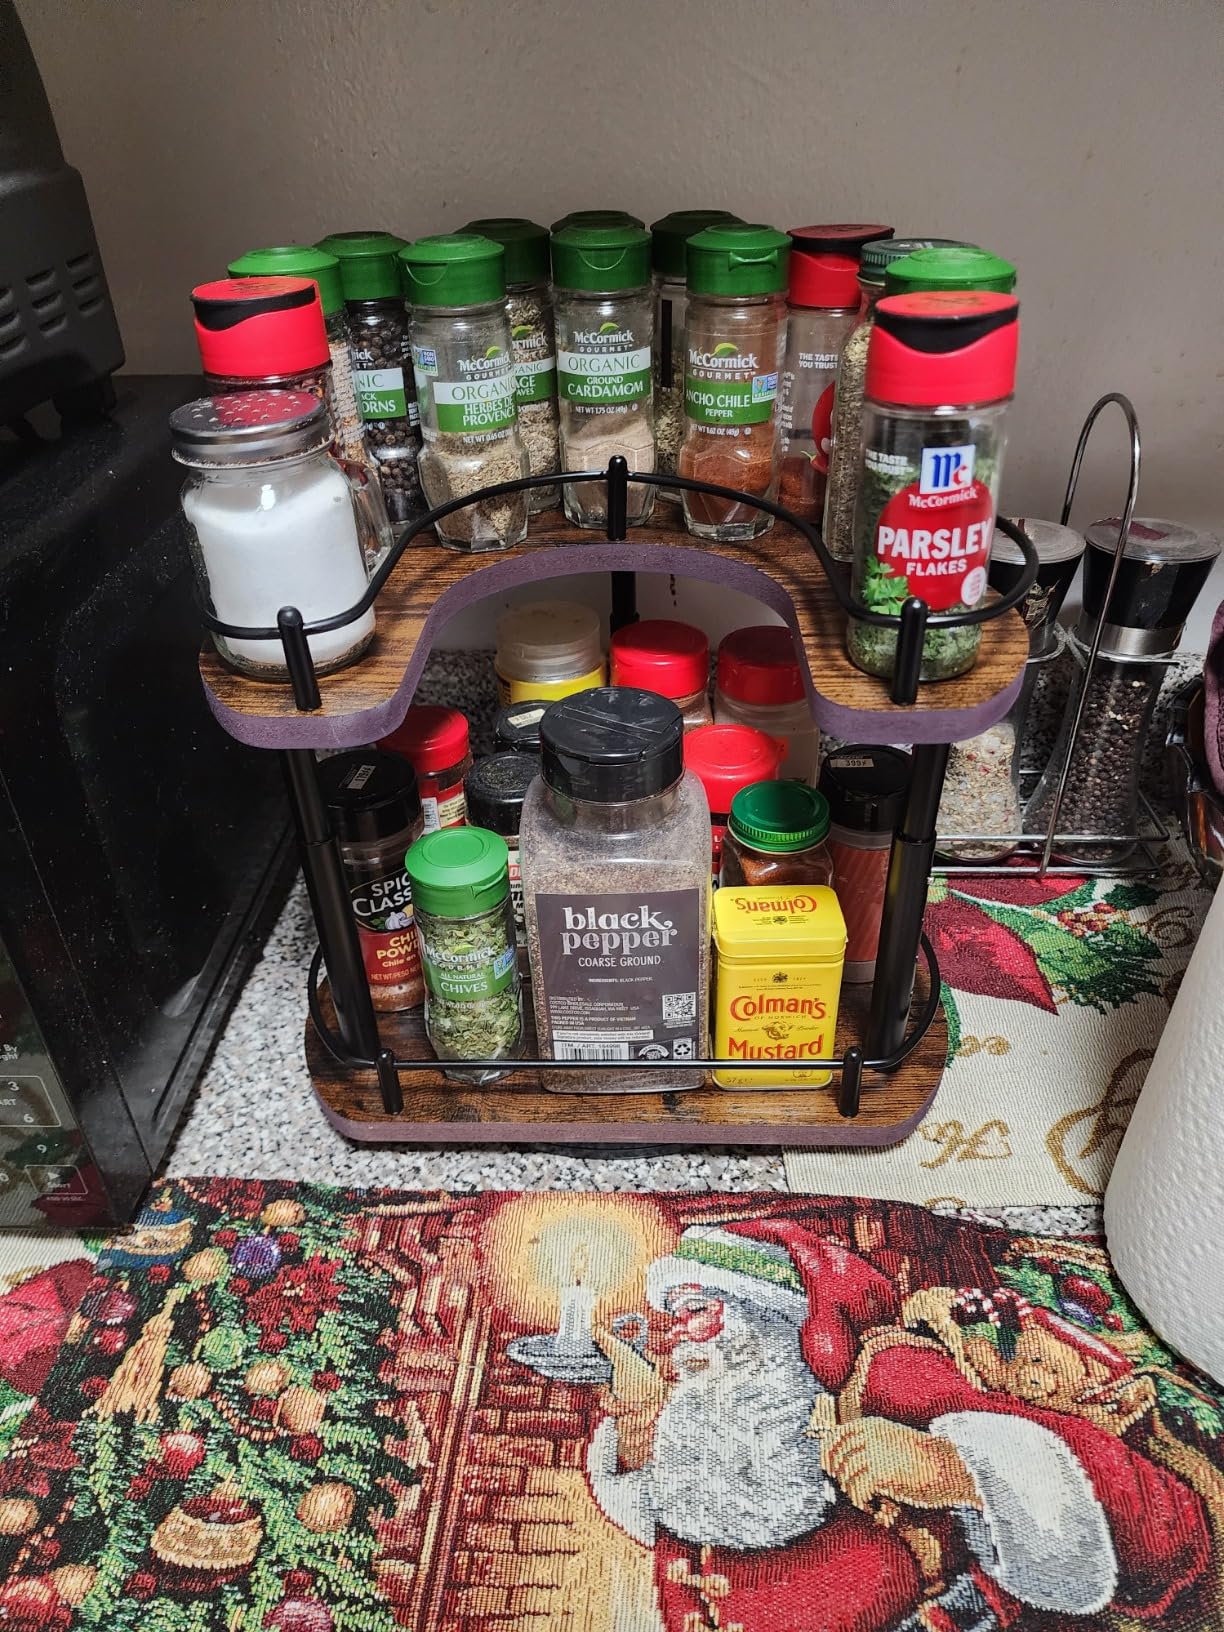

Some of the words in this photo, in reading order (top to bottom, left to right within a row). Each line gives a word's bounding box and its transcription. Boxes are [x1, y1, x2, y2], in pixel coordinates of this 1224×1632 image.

[573, 329, 634, 344] McCormick
[580, 345, 628, 353] GOURMET
[799, 352, 813, 360] THE
[568, 354, 640, 372] ORGANIC
[689, 349, 759, 368] McCormick
[799, 360, 813, 368] YOU
[587, 376, 623, 385] GROUND
[692, 368, 748, 380] GOURMET
[568, 381, 643, 397] CARDAMOM
[464, 400, 503, 415] HERBES
[504, 395, 513, 406] DE
[717, 394, 750, 408] CHILE
[463, 405, 516, 426] PROVENCE
[585, 406, 594, 414] WT
[705, 408, 733, 417] PEPPER
[908, 486, 978, 509] McCormick
[877, 517, 993, 559] PARSLEY
[906, 558, 968, 576] FLAKES
[352, 886, 412, 917] CLASS
[734, 895, 817, 914] Colman's
[562, 905, 673, 930] black
[560, 929, 678, 956] pepper
[425, 945, 497, 962] McCormick
[382, 959, 405, 967] Chile
[578, 957, 617, 968] COARSE
[620, 955, 661, 967] GROUND
[453, 972, 485, 980] NATURAL
[441, 981, 488, 993] CHIVES
[730, 993, 826, 1022] Colman's
[728, 1033, 824, 1059] Mustard
[0, 1053, 18, 1061] ght
[8, 1081, 19, 1091] 3
[23, 1113, 34, 1123] 6
[36, 1144, 47, 1153] 9
